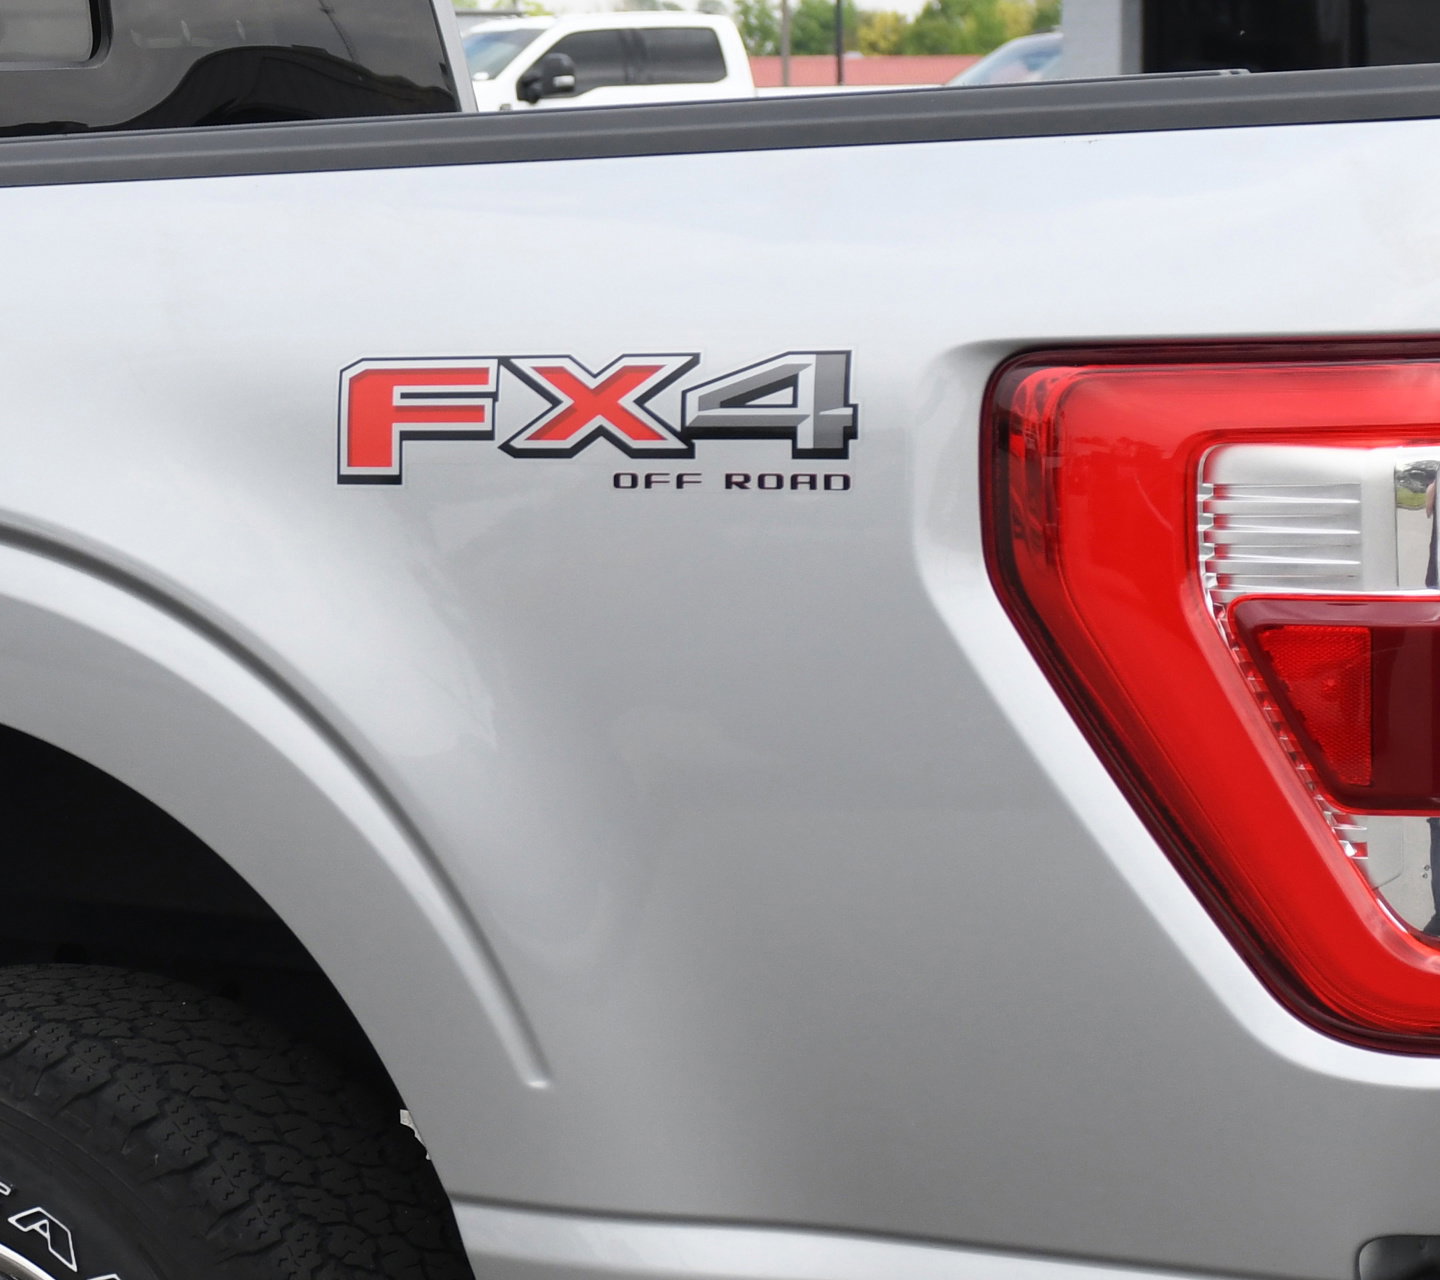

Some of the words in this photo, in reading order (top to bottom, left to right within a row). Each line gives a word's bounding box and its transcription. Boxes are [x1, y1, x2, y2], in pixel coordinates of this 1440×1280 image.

[336, 350, 859, 485] FX4
[613, 472, 703, 490] OFF
[724, 473, 851, 491] ROAD
